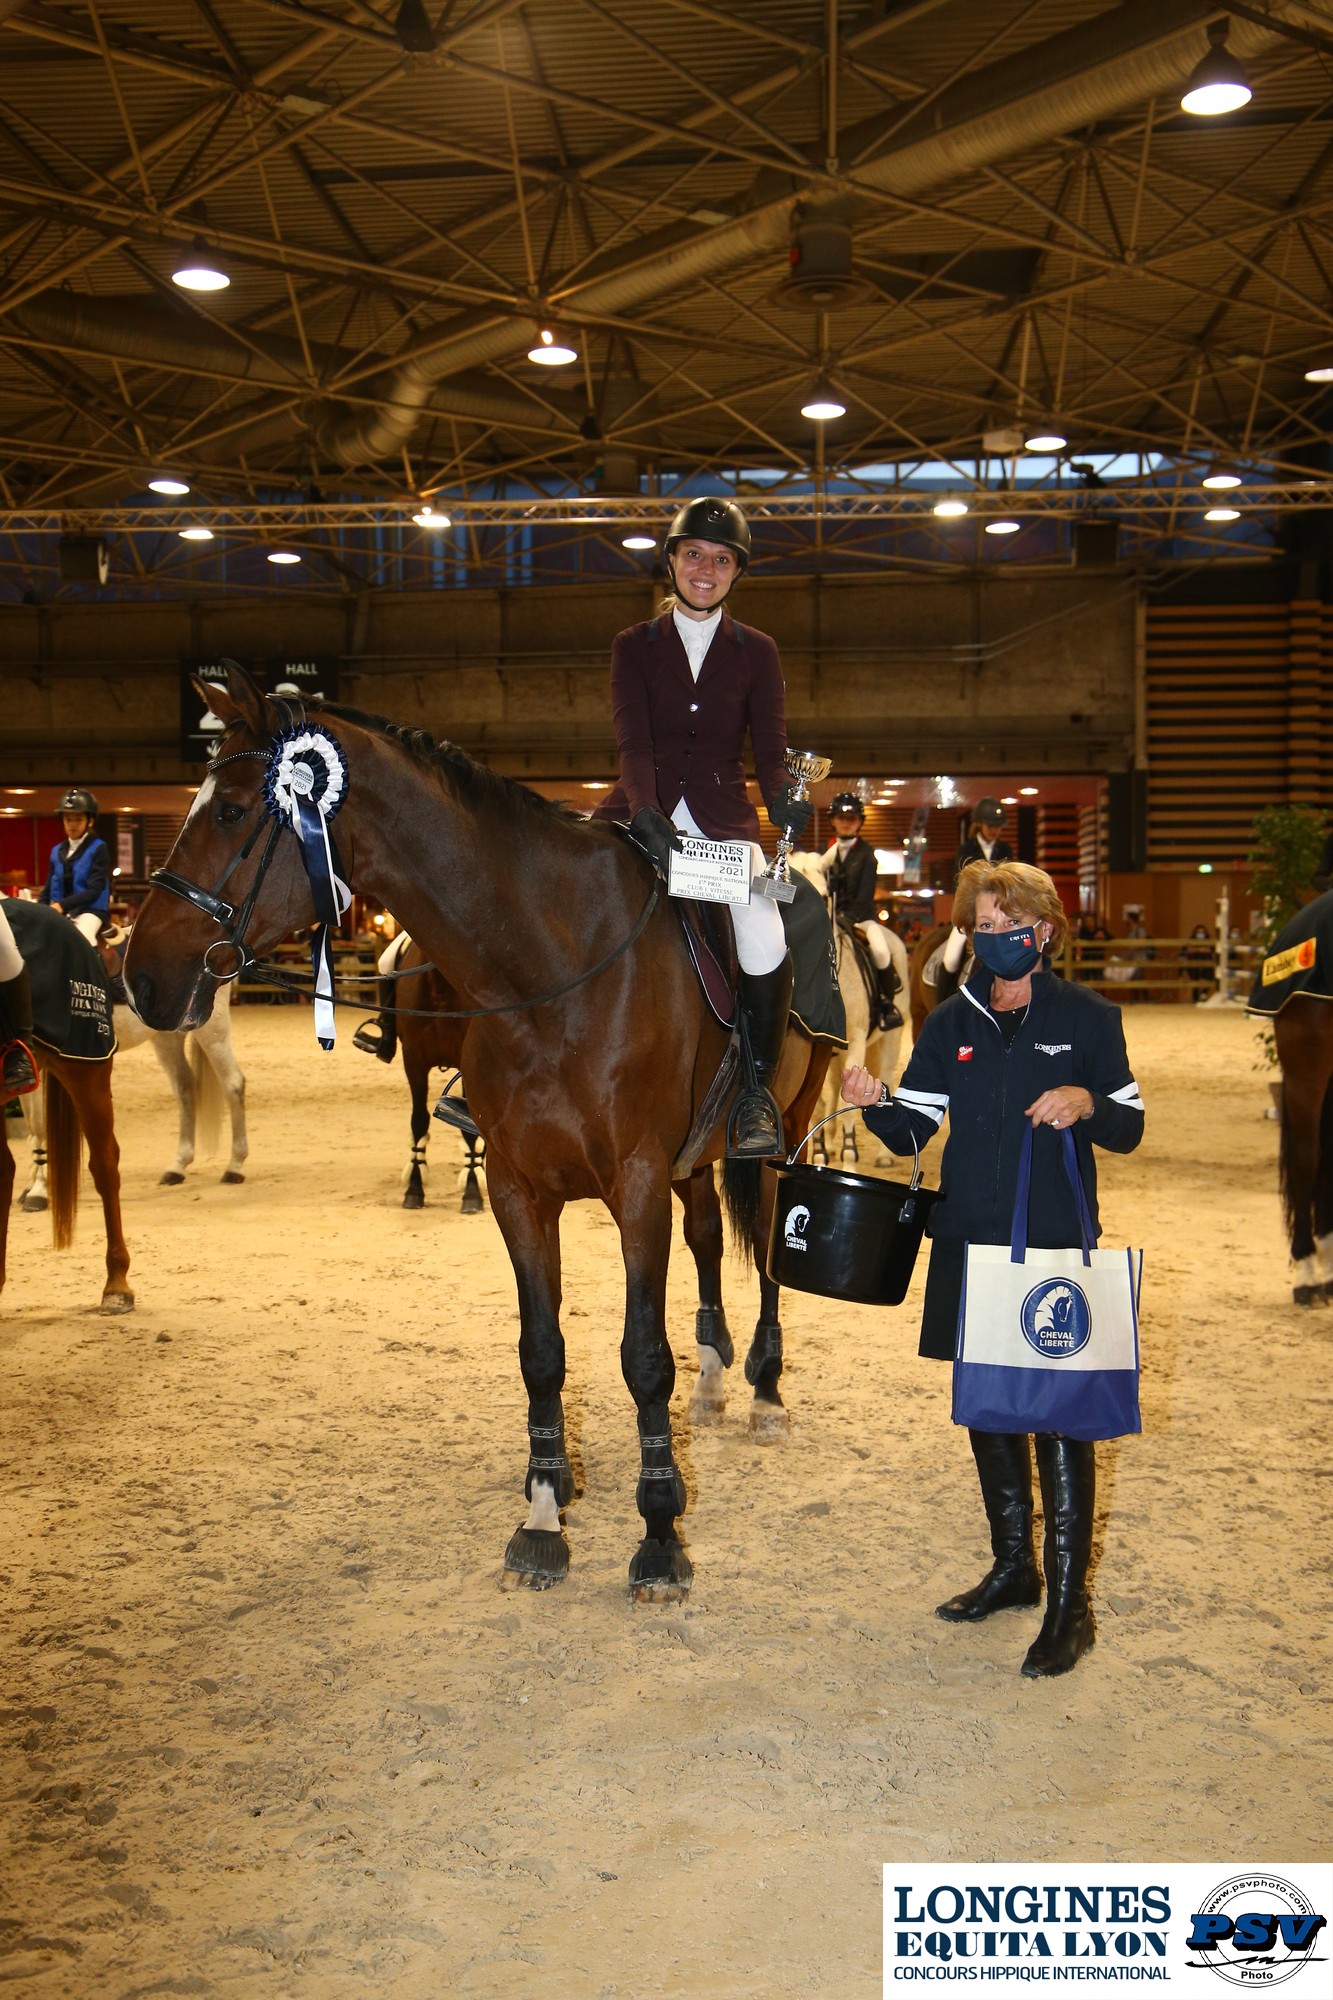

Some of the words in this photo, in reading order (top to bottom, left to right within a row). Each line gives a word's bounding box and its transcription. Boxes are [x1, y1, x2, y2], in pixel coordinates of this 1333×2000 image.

[285, 663, 318, 676] HALL
[295, 780, 306, 790] 2021
[680, 850, 715, 859] EQUITA
[718, 854, 743, 863] LYON
[719, 866, 744, 876] 2021
[671, 870, 699, 878] CONCOURS
[699, 874, 723, 882] HIPPIQUE
[724, 877, 748, 885] NATIONAL
[693, 890, 716, 898] CHEVAL
[709, 888, 734, 896] VITESSE
[1034, 1043, 1071, 1052] LONGINES
[787, 1235, 807, 1245] CHEVAL
[1040, 1331, 1074, 1339] CHEVAL
